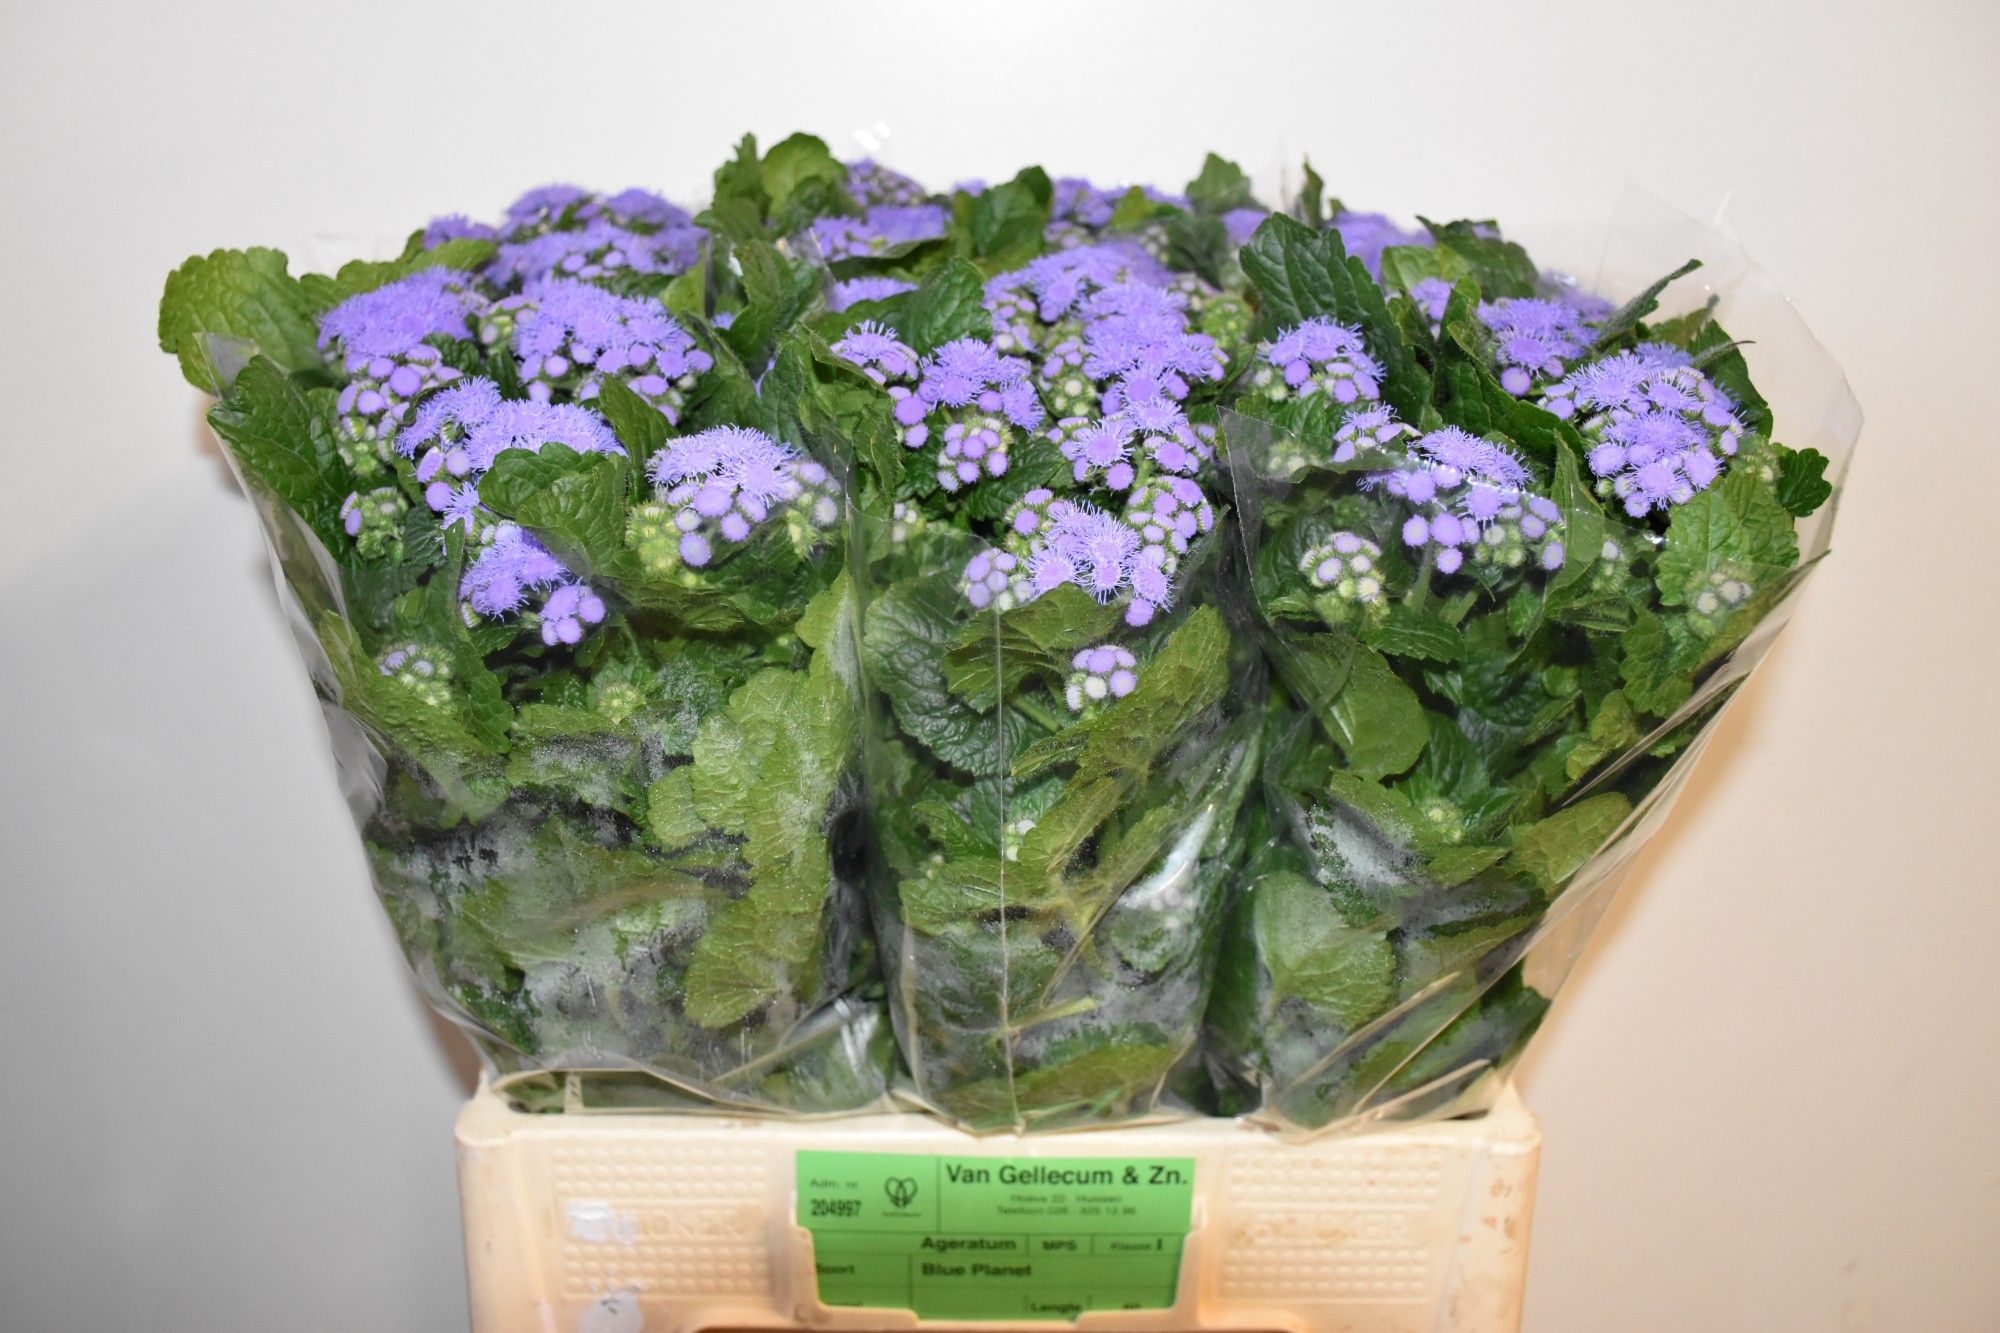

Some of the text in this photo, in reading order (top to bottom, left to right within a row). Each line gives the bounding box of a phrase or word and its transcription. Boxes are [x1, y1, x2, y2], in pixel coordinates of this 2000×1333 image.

[946, 1164, 1188, 1185] Van Gellecum & Zn.
[921, 1236, 1017, 1252] Ageratum
[921, 1262, 1032, 1276] Blue Planet
